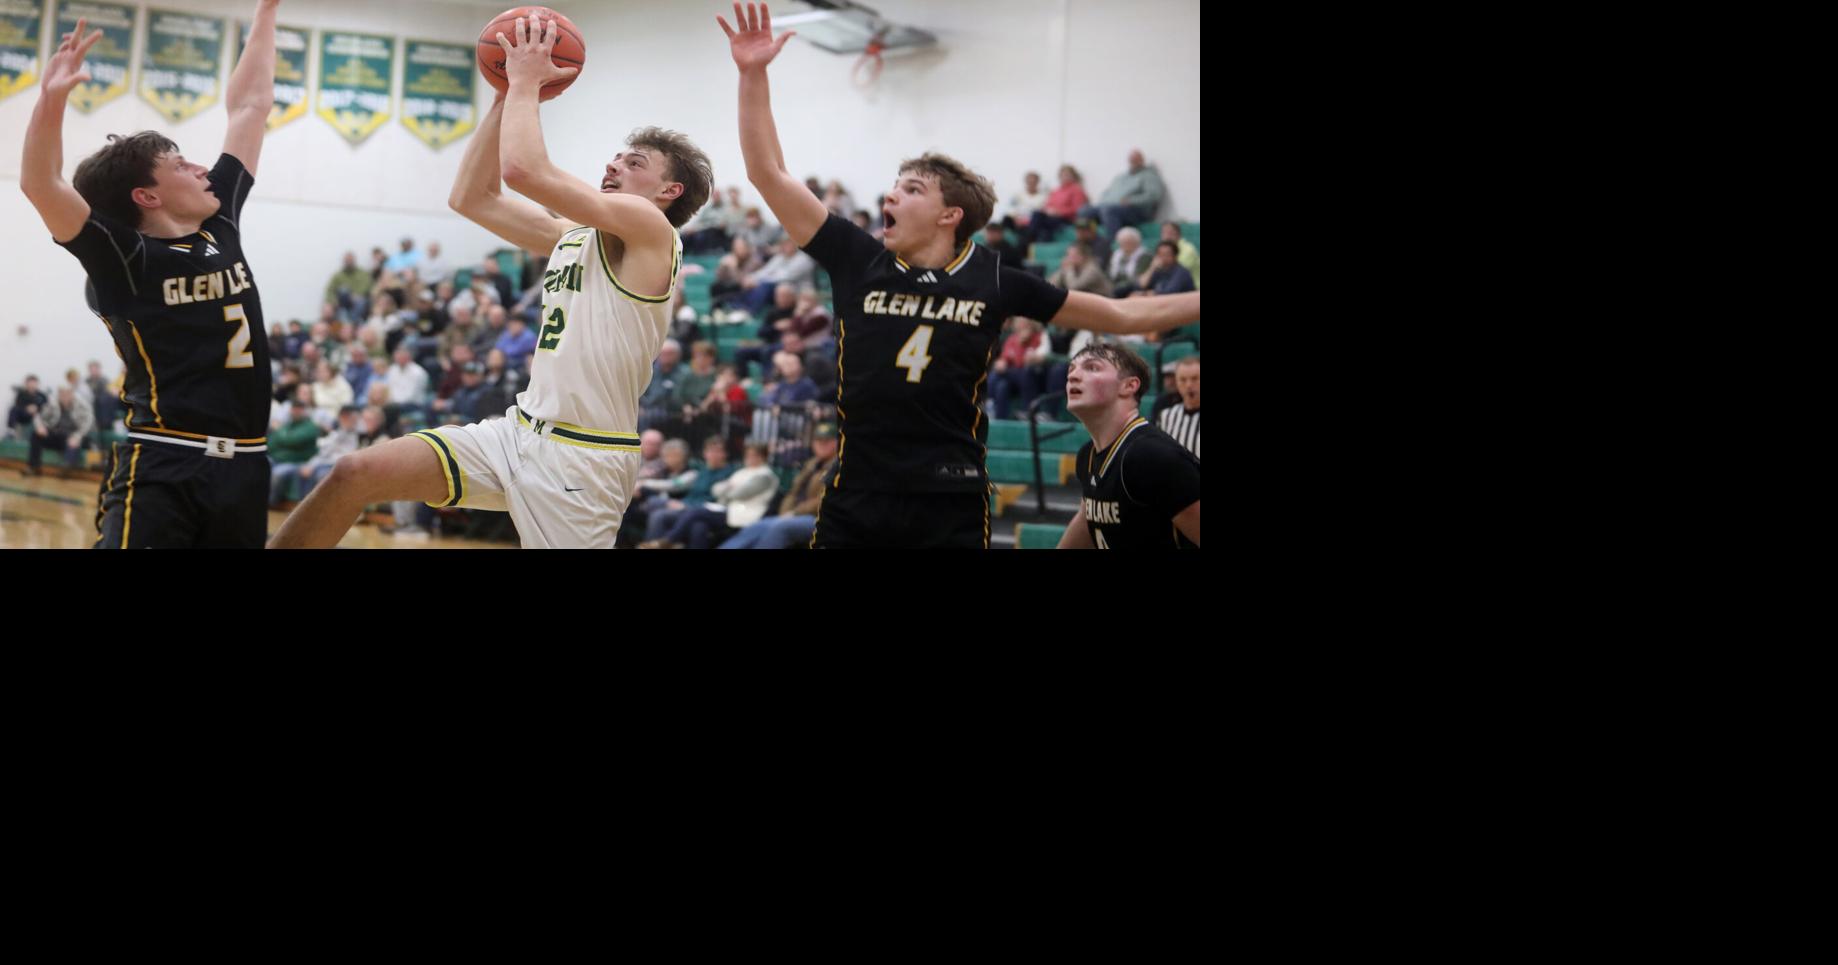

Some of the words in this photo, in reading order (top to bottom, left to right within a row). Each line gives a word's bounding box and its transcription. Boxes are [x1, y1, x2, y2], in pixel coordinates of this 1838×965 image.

[162, 270, 225, 306] GLEN
[863, 291, 922, 317] GLEN
[921, 297, 986, 326] LAKE
[223, 303, 254, 369] 2
[895, 324, 934, 383] 4
[533, 418, 546, 435] M
[1093, 499, 1121, 524] LAKE
